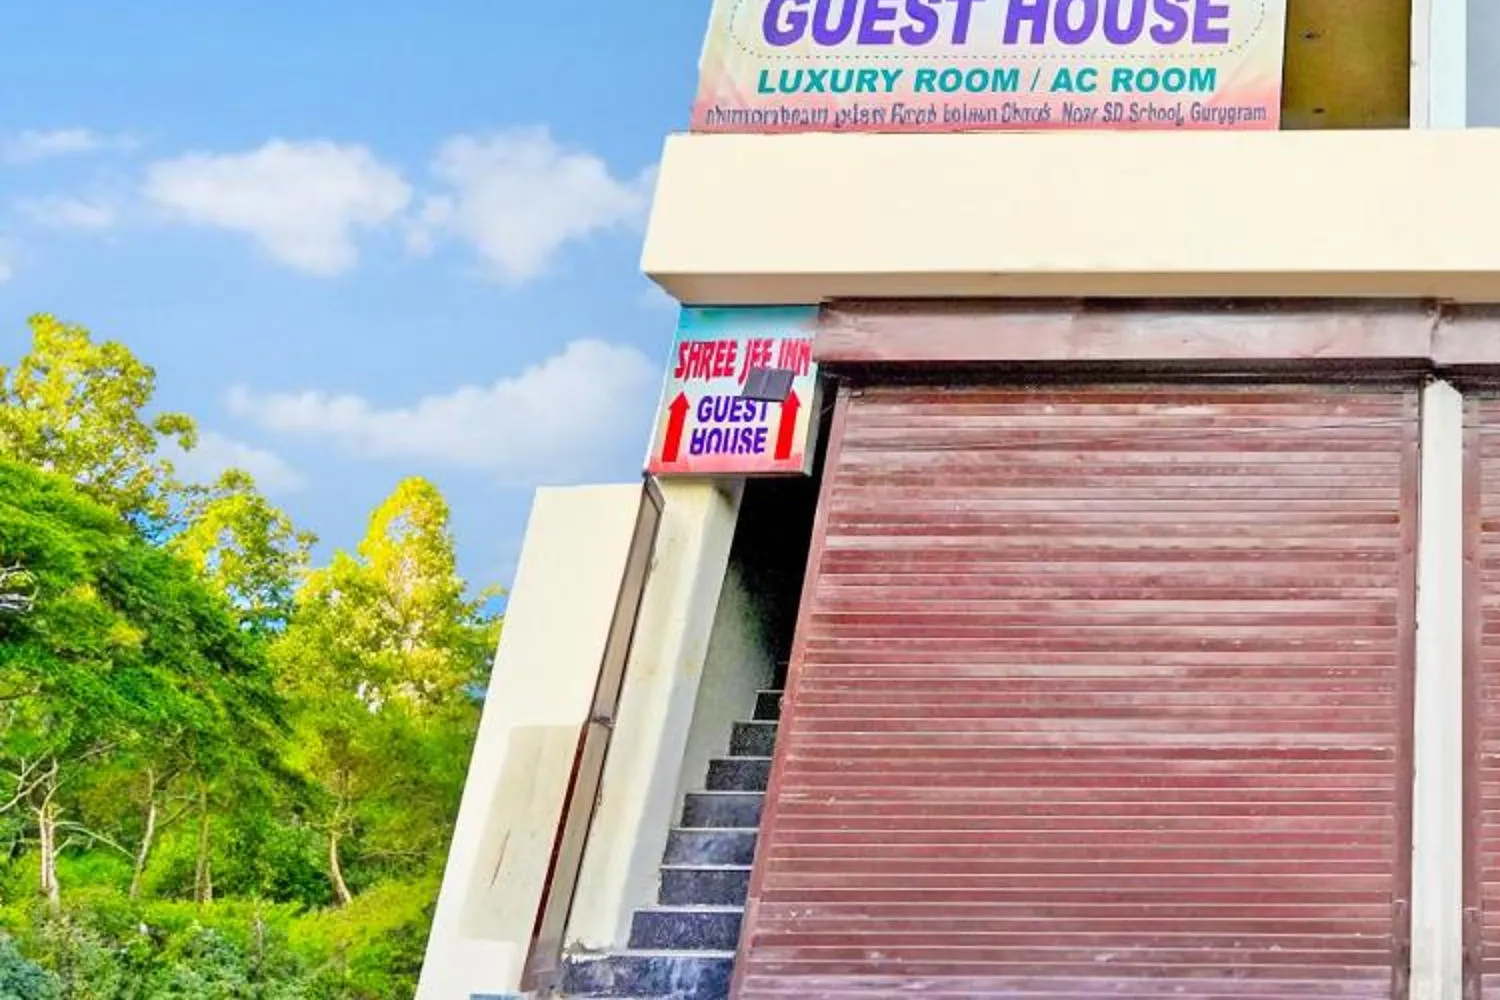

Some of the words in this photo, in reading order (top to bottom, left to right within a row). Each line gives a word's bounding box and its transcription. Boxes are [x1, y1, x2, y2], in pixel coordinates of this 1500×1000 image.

[757, 67, 901, 93] LUXURY
[913, 66, 1022, 93] ROOM
[1049, 66, 1099, 93] AC
[1110, 66, 1217, 93] ROOM
[1102, 103, 1125, 123] SD
[674, 339, 739, 383] SHREE
[738, 338, 774, 385] JEE
[777, 337, 813, 377] INN
[697, 395, 769, 423] GUEST
[689, 427, 769, 456] HOUSE
